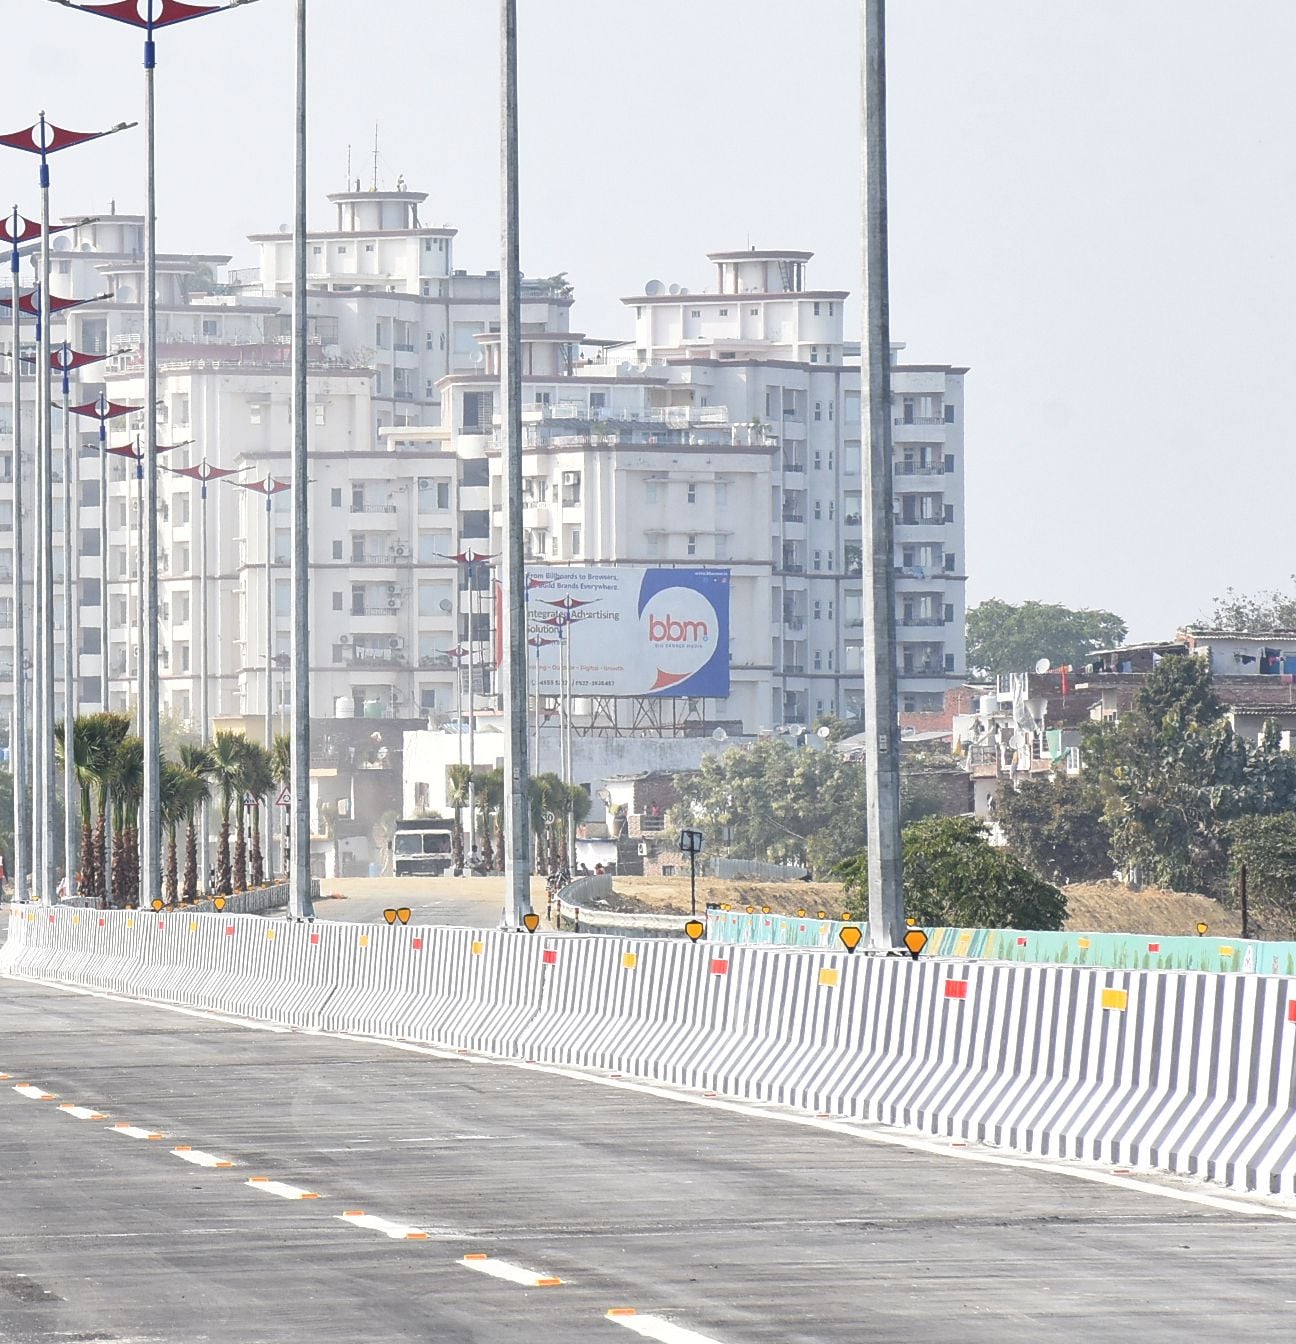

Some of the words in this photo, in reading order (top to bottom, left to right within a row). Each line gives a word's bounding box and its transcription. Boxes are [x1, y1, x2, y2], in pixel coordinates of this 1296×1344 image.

[526, 610, 569, 620] ntegrate
[571, 609, 620, 622] Advertising
[649, 613, 708, 642] bbm
